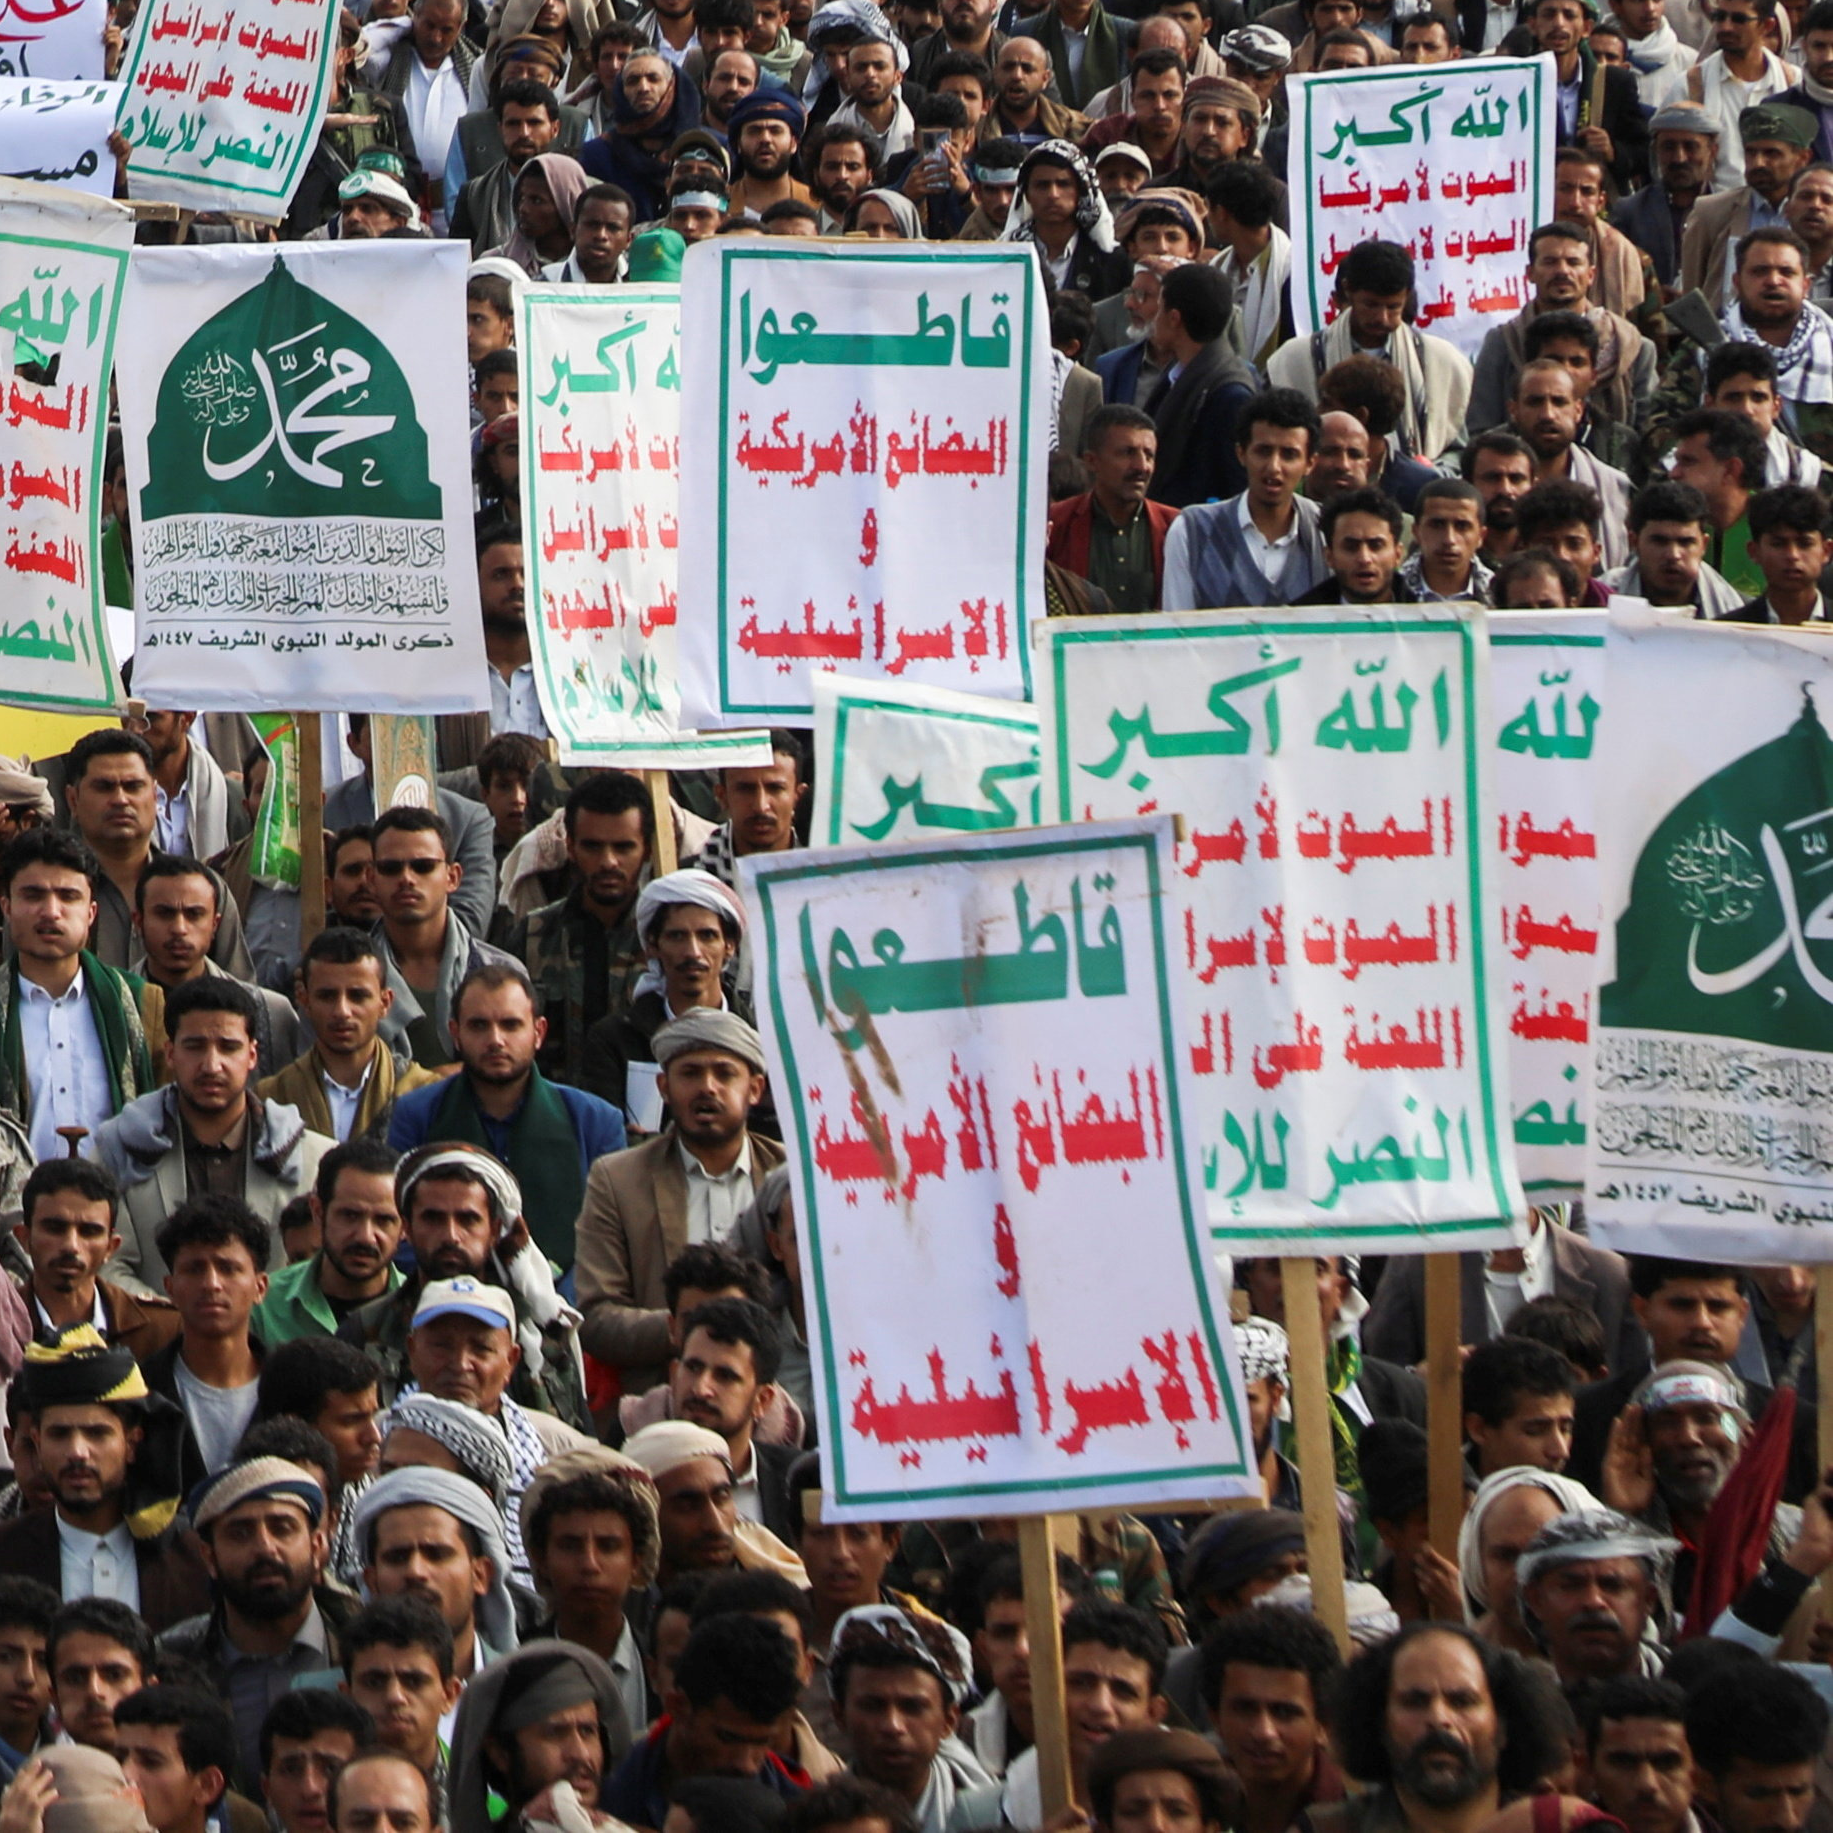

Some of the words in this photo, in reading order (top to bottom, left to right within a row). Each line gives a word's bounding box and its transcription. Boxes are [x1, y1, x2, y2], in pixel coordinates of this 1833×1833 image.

[152, 2, 235, 51] لإسرائيل
[238, 23, 319, 62] الموت
[136, 61, 200, 101] اليهود
[197, 63, 235, 102] على
[243, 70, 309, 116] اللعنة
[120, 105, 207, 165] للإسلام
[199, 121, 294, 172] النصر
[741, 292, 1011, 384] قاطعوا
[202, 322, 396, 487] محمد
[736, 406, 877, 487] الأمريكية
[886, 416, 1007, 489] البضائع
[857, 508, 878, 566] و
[143, 632, 192, 647] ١٤٤٧هـ
[198, 630, 265, 650] الشريف
[272, 632, 326, 652] النبوي
[336, 631, 386, 650] المولد
[393, 633, 453, 651] ذكرى
[738, 597, 1007, 675] الإسرائيلية
[1081, 649, 1301, 791] أكبر
[1315, 658, 1450, 754] الله
[1296, 798, 1453, 873] الموت
[797, 872, 1130, 1048] قاطعوا
[1304, 904, 1457, 980] الموت
[1253, 1013, 1323, 1089] على
[1344, 1007, 1463, 1079] اللعنة
[809, 1057, 997, 1204] الأمريكية
[1013, 1067, 1163, 1192] البضائع
[1312, 1098, 1474, 1210] النصر
[993, 1203, 1020, 1297] و
[849, 1331, 1218, 1467] الإسرائيلية
